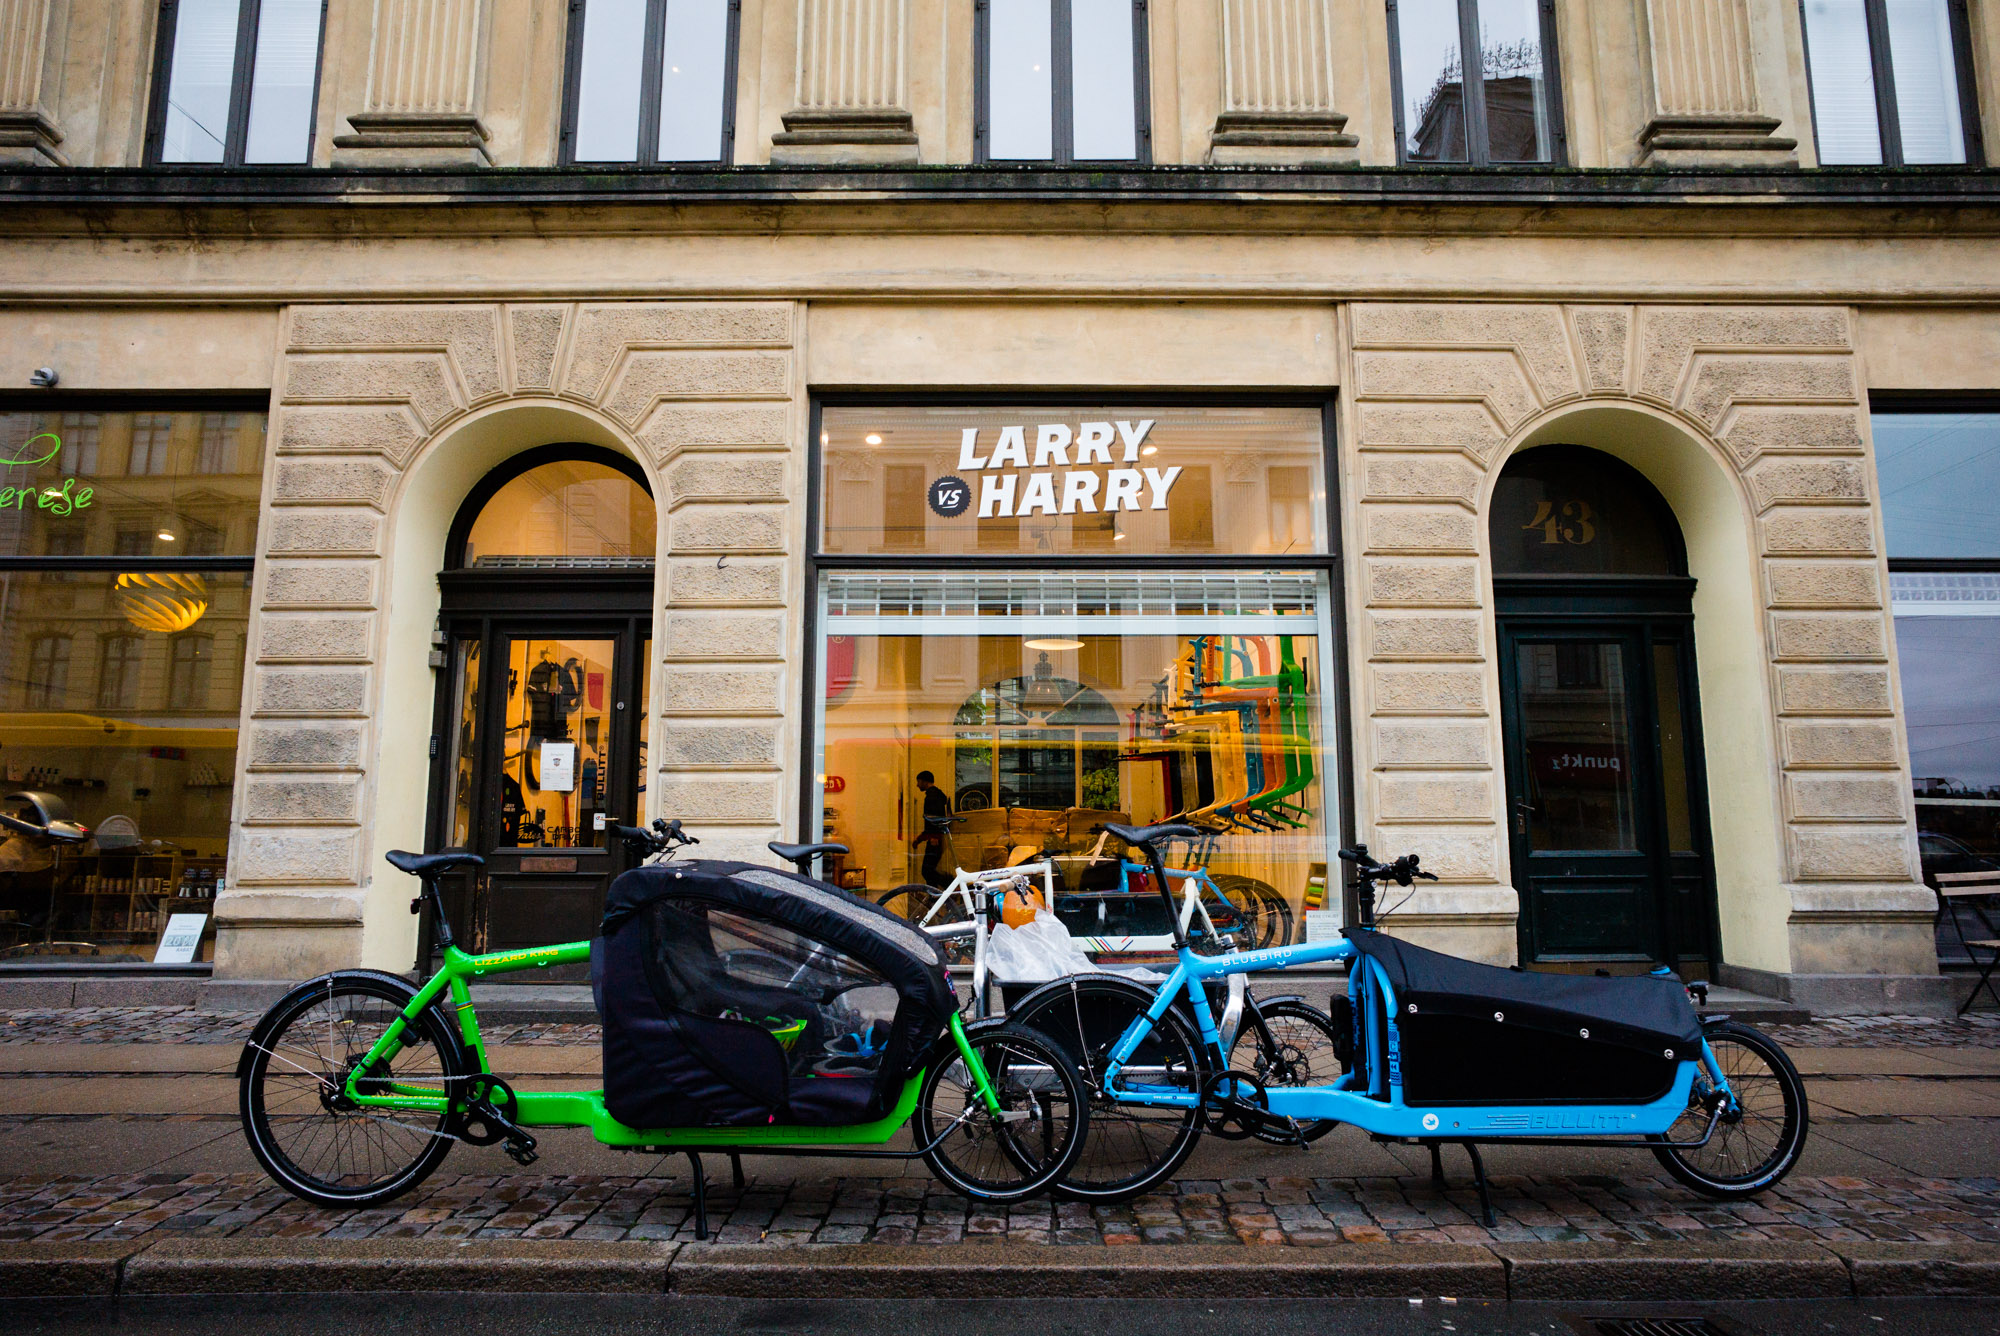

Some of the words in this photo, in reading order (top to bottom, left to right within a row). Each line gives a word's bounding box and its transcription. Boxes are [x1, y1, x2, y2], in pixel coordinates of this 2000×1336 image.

[957, 419, 1157, 471] LARRY
[937, 489, 963, 506] VS
[977, 466, 1184, 519] HARRY
[1521, 501, 1596, 545] 43
[474, 953, 527, 966] LIZZARD
[529, 949, 559, 959] KING
[1222, 949, 1292, 967] BLUEBIRD
